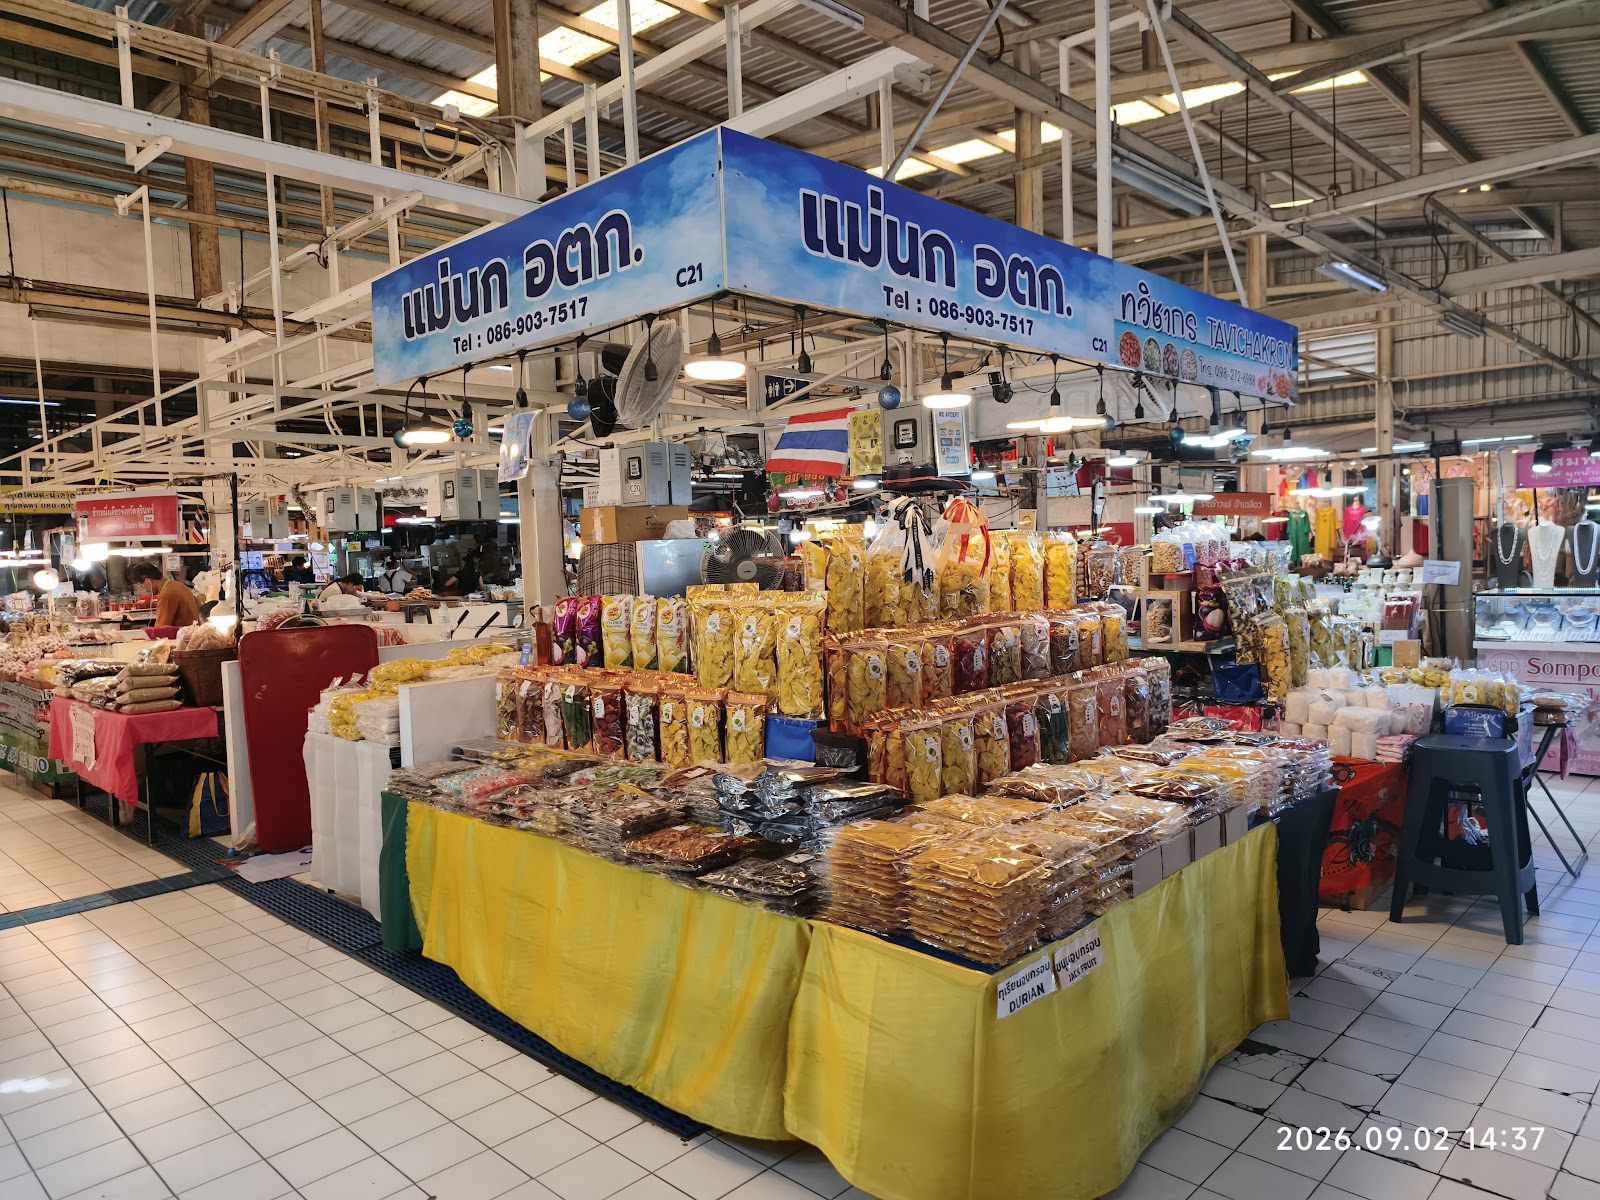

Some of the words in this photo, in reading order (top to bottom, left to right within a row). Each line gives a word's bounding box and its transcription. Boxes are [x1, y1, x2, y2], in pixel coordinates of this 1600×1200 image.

[800, 184, 957, 290] แม่นก
[973, 243, 1074, 319] อตก.
[401, 257, 508, 341] แม่นก
[523, 209, 644, 301] อตก.
[675, 263, 703, 288] C21
[453, 333, 472, 355] Tel
[486, 297, 588, 346] 086-903-7517
[883, 286, 909, 310] Tel
[929, 297, 1034, 336] 086-903-7517
[1120, 280, 1198, 344] ทวิชากร
[1206, 316, 1293, 370] TAVICHAKRON
[1092, 338, 1108, 353] C21
[630, 484, 641, 493] C20
[138, 520, 150, 529] Rice
[1056, 938, 1101, 973] ขนุนอบกรอบ
[1080, 957, 1097, 975] FRUIT
[998, 961, 1050, 1001] ทุเรียนอบกรอบ
[1009, 982, 1045, 1013] DURIAN
